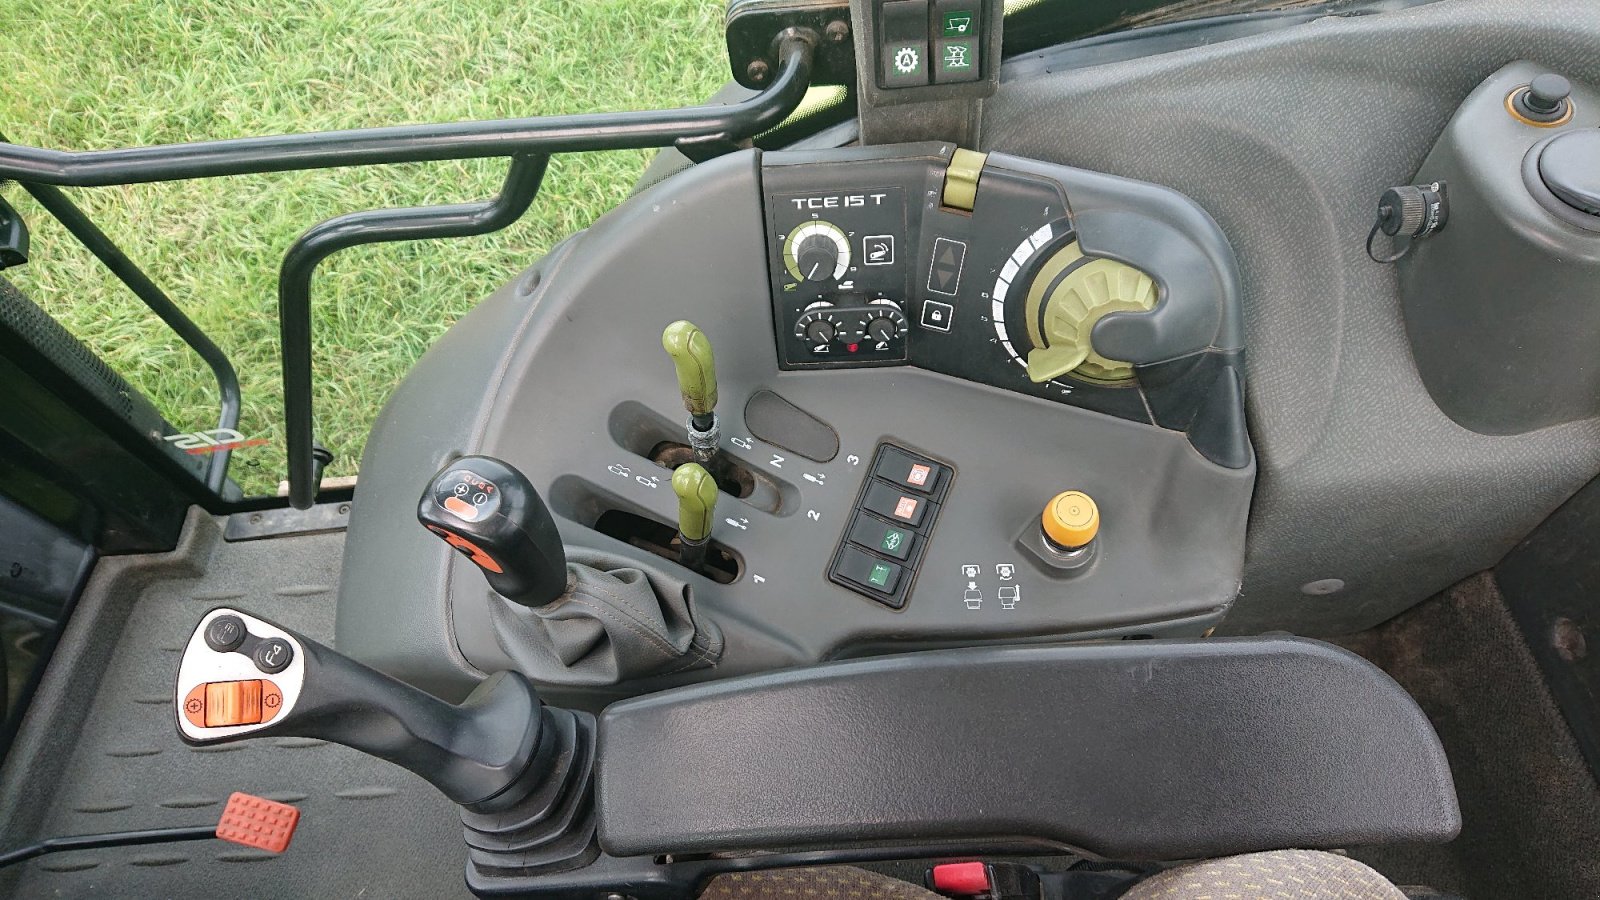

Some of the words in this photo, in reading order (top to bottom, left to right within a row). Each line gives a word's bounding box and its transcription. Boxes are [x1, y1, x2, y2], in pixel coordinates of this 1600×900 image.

[901, 53, 911, 66] A
[791, 196, 840, 210] TCE
[844, 194, 865, 208] 15
[869, 193, 887, 205] T
[769, 454, 785, 469] N
[847, 454, 860, 466] 3
[807, 509, 821, 522] 2
[753, 573, 766, 584] 1
[265, 644, 282, 666] F4
